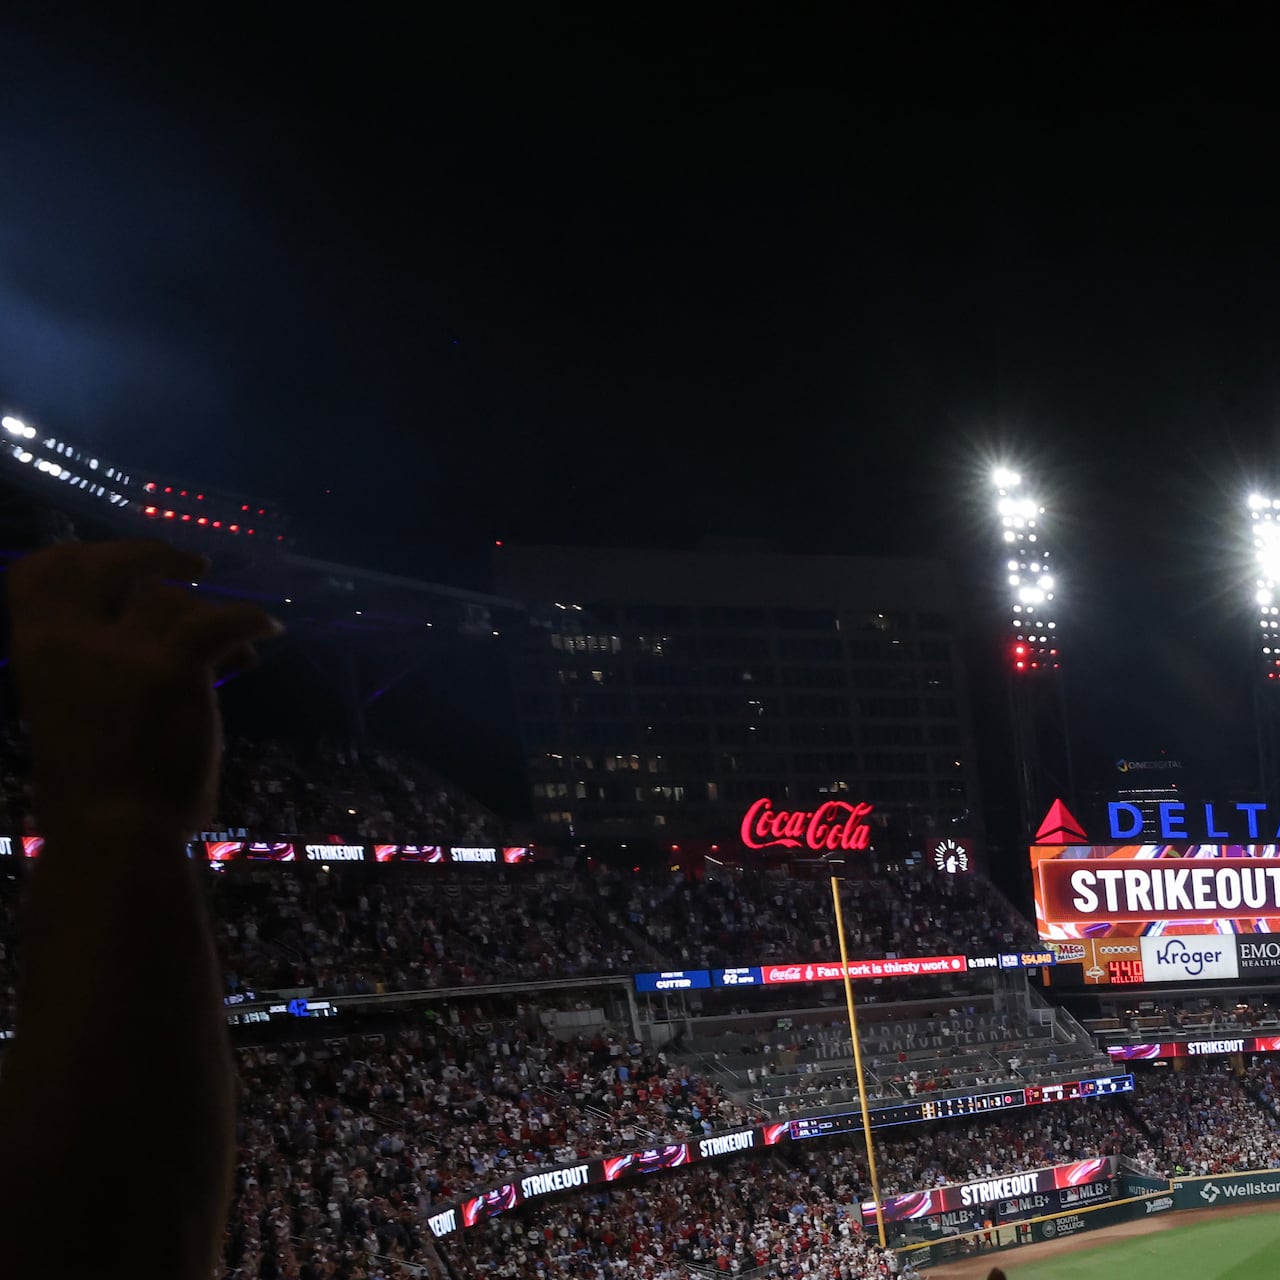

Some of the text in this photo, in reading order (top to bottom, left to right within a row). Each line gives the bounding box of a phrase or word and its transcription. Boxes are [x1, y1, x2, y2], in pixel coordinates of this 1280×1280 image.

[741, 798, 874, 850] Coca-Cola
[306, 844, 365, 861] STRIKEOUT
[450, 847, 496, 862] STRIKEOUT
[1059, 944, 1084, 954] MEGA
[1157, 939, 1222, 975] Kroger
[769, 967, 802, 981] Coca-Cola
[817, 966, 839, 977] Fan
[872, 963, 882, 973] is
[883, 960, 920, 973] thirsty
[922, 958, 950, 970] work
[1109, 961, 1142, 976] 440
[656, 979, 691, 989] CUTTER
[723, 975, 737, 984] 92
[1111, 975, 1143, 984] MILLION
[288, 998, 310, 1017] 42
[1187, 1039, 1244, 1055] STRIKEOUT
[699, 1130, 754, 1158] STRIKEOUT
[521, 1165, 590, 1199] STRIKEOUT
[960, 1173, 1038, 1206] STRIKEOUT
[1078, 1183, 1110, 1199] MLB+
[1019, 1195, 1050, 1212] MLB+
[941, 1208, 975, 1228] MLB+
[1056, 1215, 1079, 1226] SOUTH
[1056, 1220, 1085, 1232] COLLEGE
